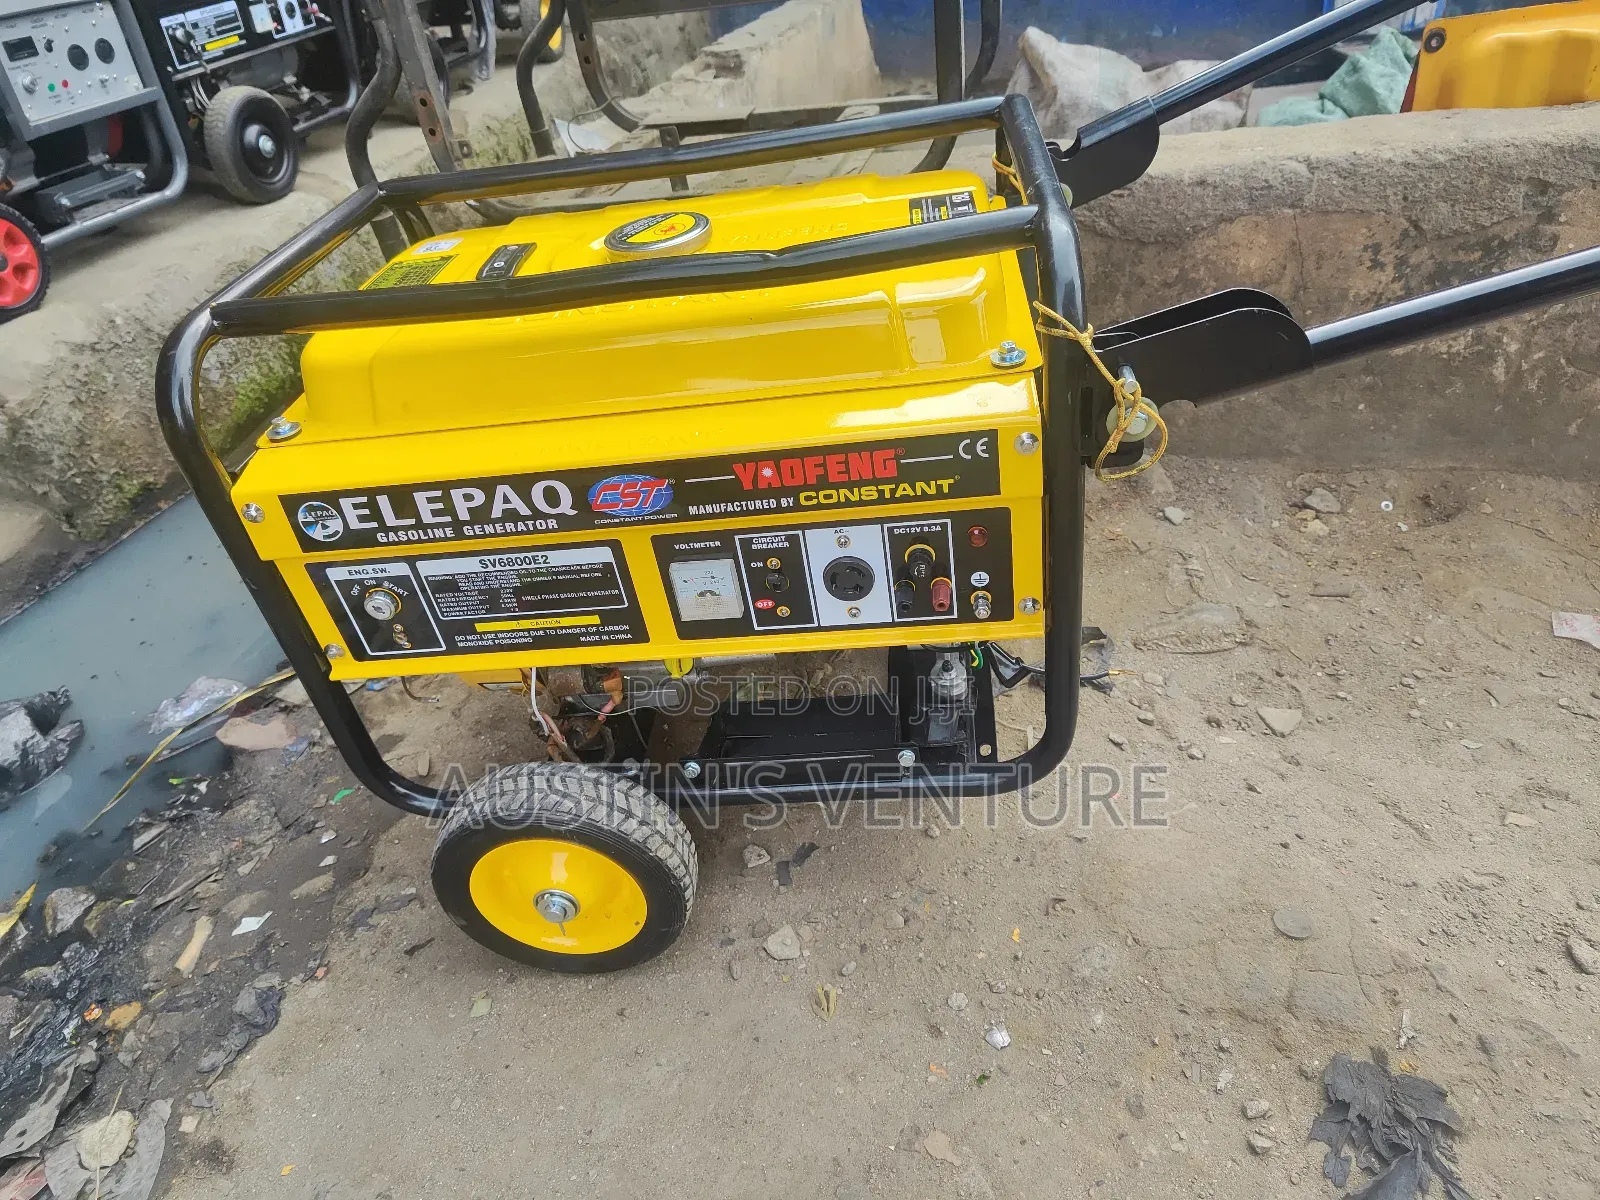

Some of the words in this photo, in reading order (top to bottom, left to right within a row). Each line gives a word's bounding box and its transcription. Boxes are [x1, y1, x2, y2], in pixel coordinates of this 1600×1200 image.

[732, 448, 898, 491] YAOFENG
[958, 436, 989, 460] CE
[591, 479, 668, 512] CST
[688, 498, 777, 515] MANUFACTURED
[780, 496, 794, 508] BY
[799, 478, 955, 506] CONSTANT
[338, 479, 578, 529] ELEPAQ
[594, 516, 644, 525] CONSTANT
[376, 527, 455, 543] GASOLINE
[463, 519, 559, 536] GENERATOR
[893, 526, 921, 534] DC12V
[752, 535, 786, 544] CIRCUIT
[673, 540, 721, 550] VOLTMETER
[751, 541, 790, 550] BREAKER
[478, 555, 550, 569] SV6800E2
[350, 583, 361, 596] OFF
[382, 580, 410, 597] START
[587, 589, 620, 597] GENERATOR
[530, 619, 561, 627] CAUTION
[557, 626, 587, 635] DANGER
[599, 624, 630, 632] CARBON
[495, 637, 533, 645] POISONING
[580, 634, 600, 642] MADE
[610, 632, 633, 640] CHINA
